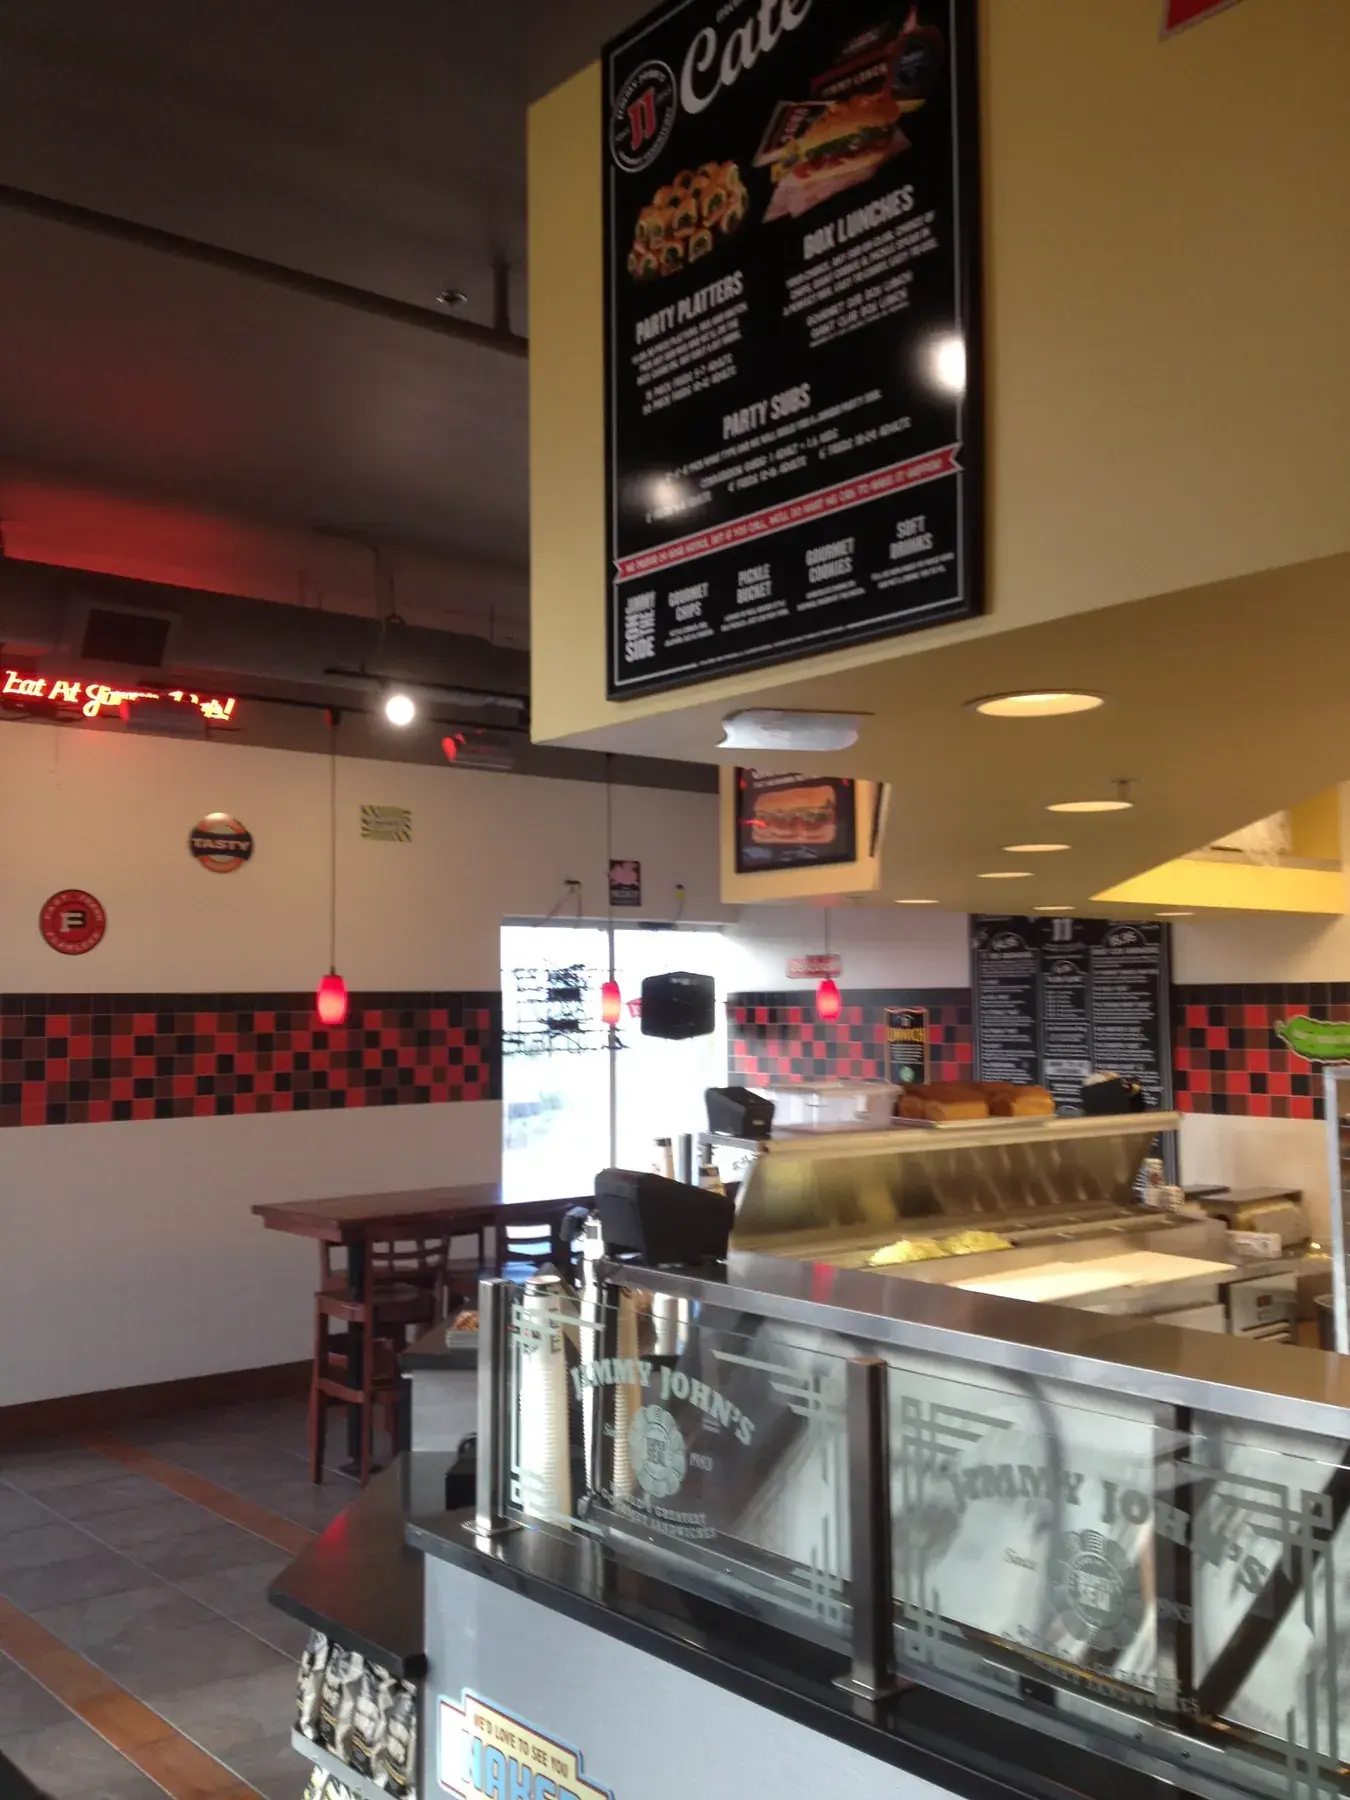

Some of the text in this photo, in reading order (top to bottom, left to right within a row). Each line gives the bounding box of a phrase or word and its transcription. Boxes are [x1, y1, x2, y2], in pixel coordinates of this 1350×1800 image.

[837, 184, 915, 244] LUNCHES
[635, 304, 675, 346] PARTY
[677, 269, 744, 324] PLATTERS
[722, 399, 768, 440] PARTY
[770, 383, 811, 420] SUBS
[896, 515, 926, 539] SOFT
[805, 537, 855, 566] GOURMET
[889, 532, 934, 560] DRINKS
[738, 563, 771, 587] PICKLE
[808, 556, 853, 583] COOKIES
[736, 580, 772, 604] BUCKET
[2, 670, 47, 697] Eat
[48, 680, 82, 703] At
[190, 837, 251, 852] TASTY
[570, 1358, 757, 1448] JIMMY JOHN'S
[950, 1463, 1085, 1514] JIMMY
[494, 1723, 517, 1749] LOVE
[518, 1736, 530, 1757] TO
[531, 1743, 548, 1768] SEE
